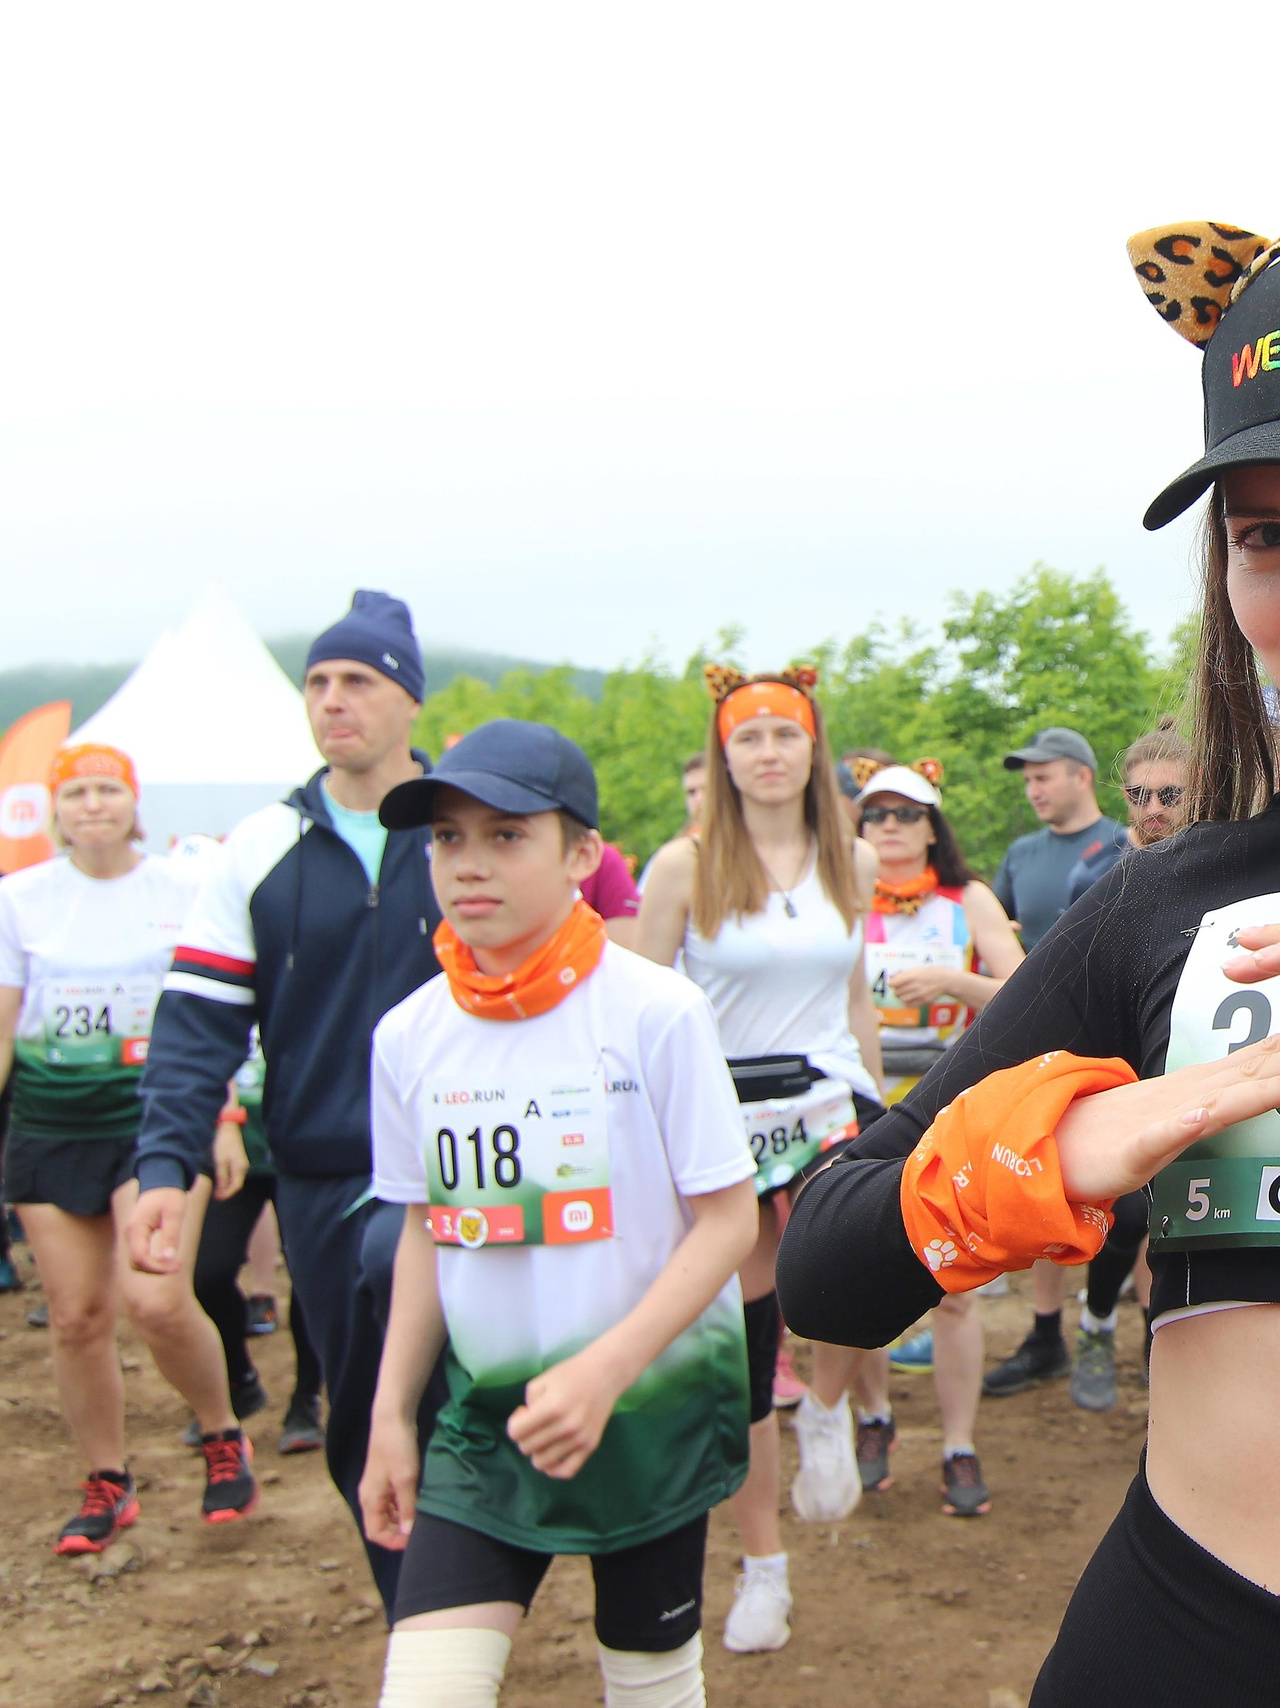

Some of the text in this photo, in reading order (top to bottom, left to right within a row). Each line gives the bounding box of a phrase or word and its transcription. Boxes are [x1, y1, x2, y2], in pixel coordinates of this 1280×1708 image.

[56, 1005, 112, 1038] 234
[445, 1089, 506, 1105] LEO.RUN
[523, 1099, 543, 1119] A
[436, 1124, 523, 1191] 018
[750, 1117, 807, 1163] 284
[1184, 1177, 1231, 1222] 5 km
